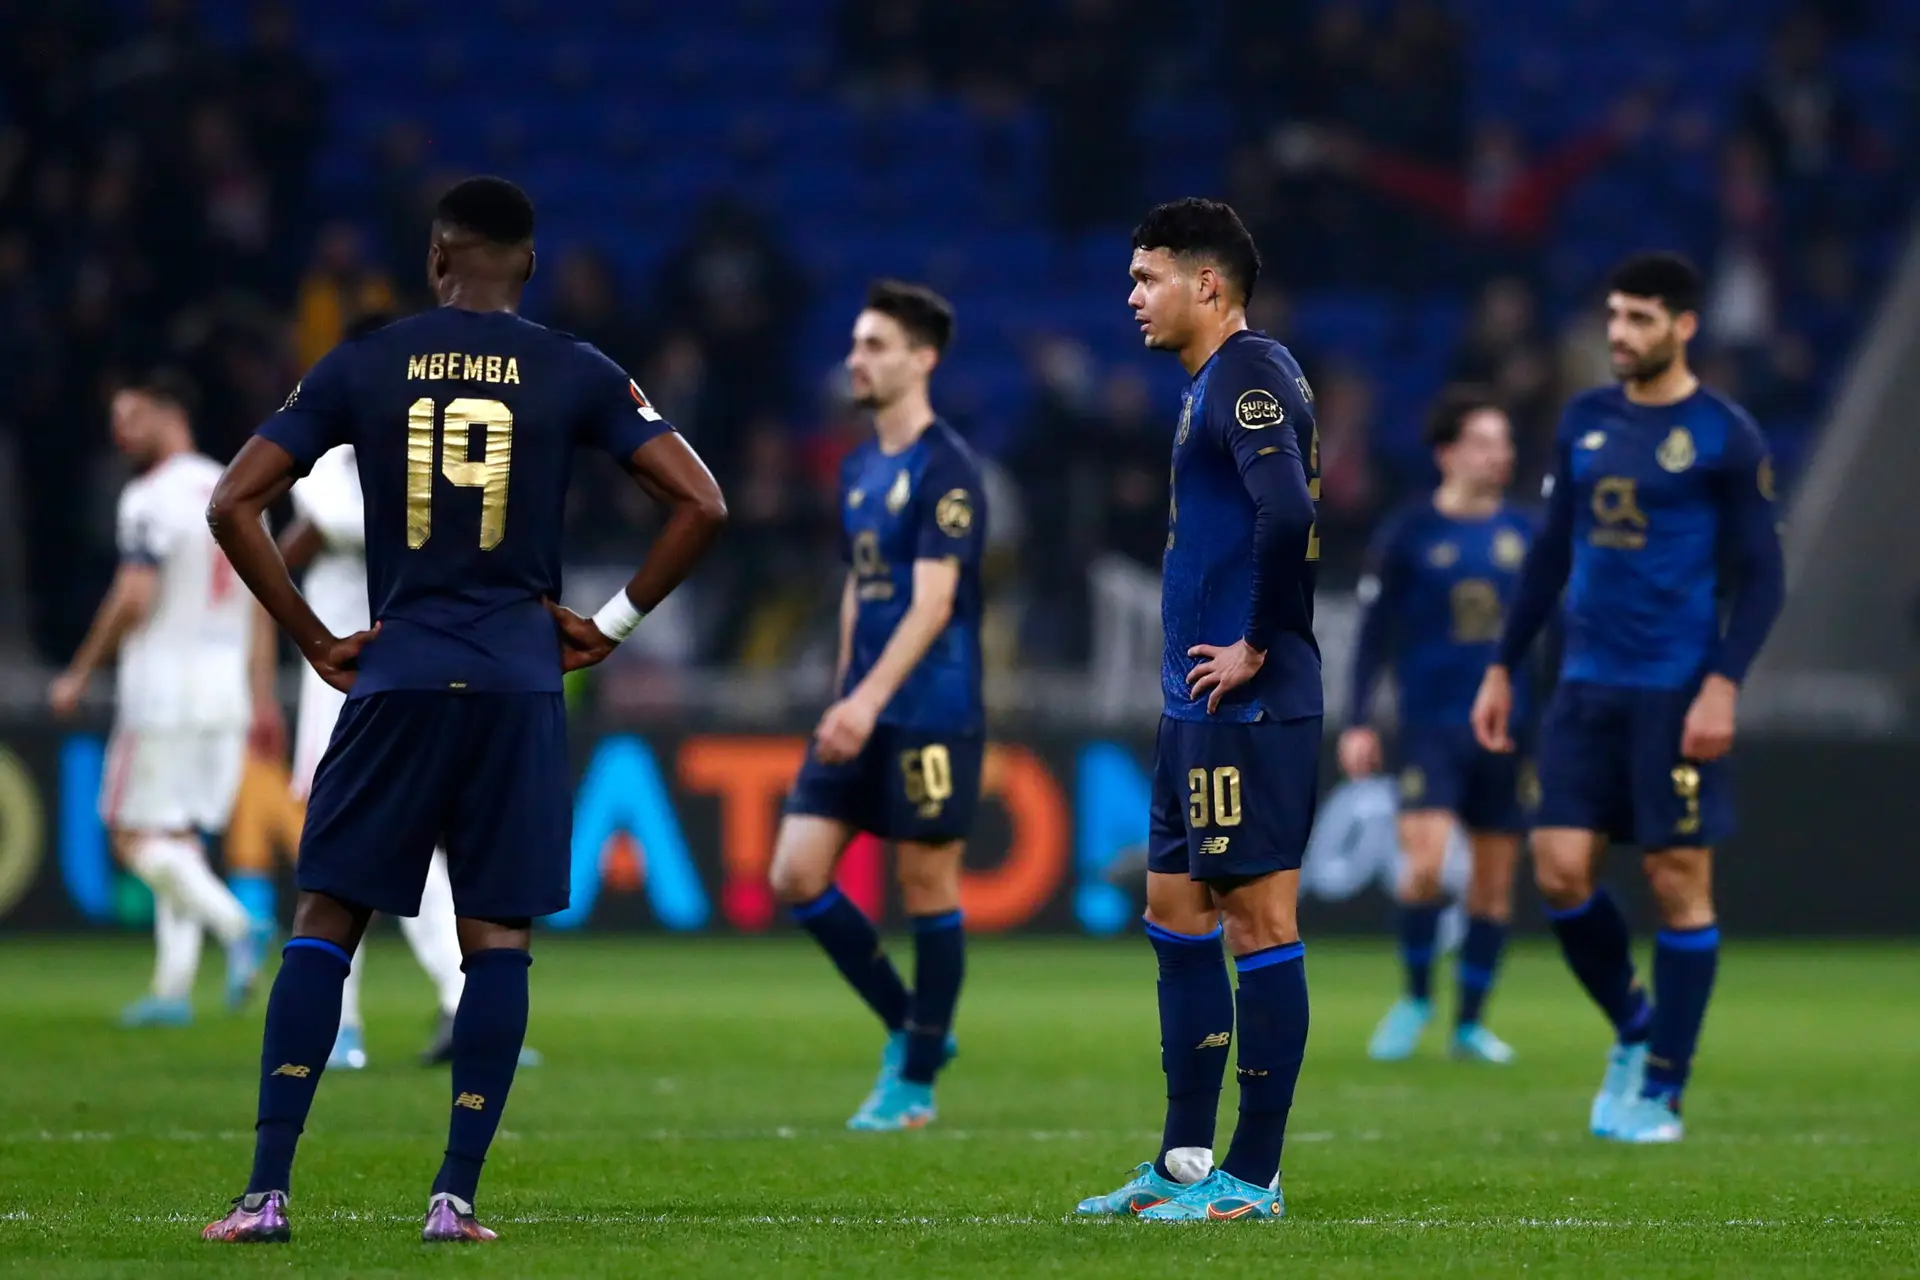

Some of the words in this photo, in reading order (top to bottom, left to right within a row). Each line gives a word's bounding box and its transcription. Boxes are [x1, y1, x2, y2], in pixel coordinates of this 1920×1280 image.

[407, 352, 520, 384] MBEMBA
[1240, 400, 1277, 413] SUPER
[1245, 409, 1278, 421] BOCK
[407, 398, 513, 551] 19
[1188, 766, 1242, 828] 30
